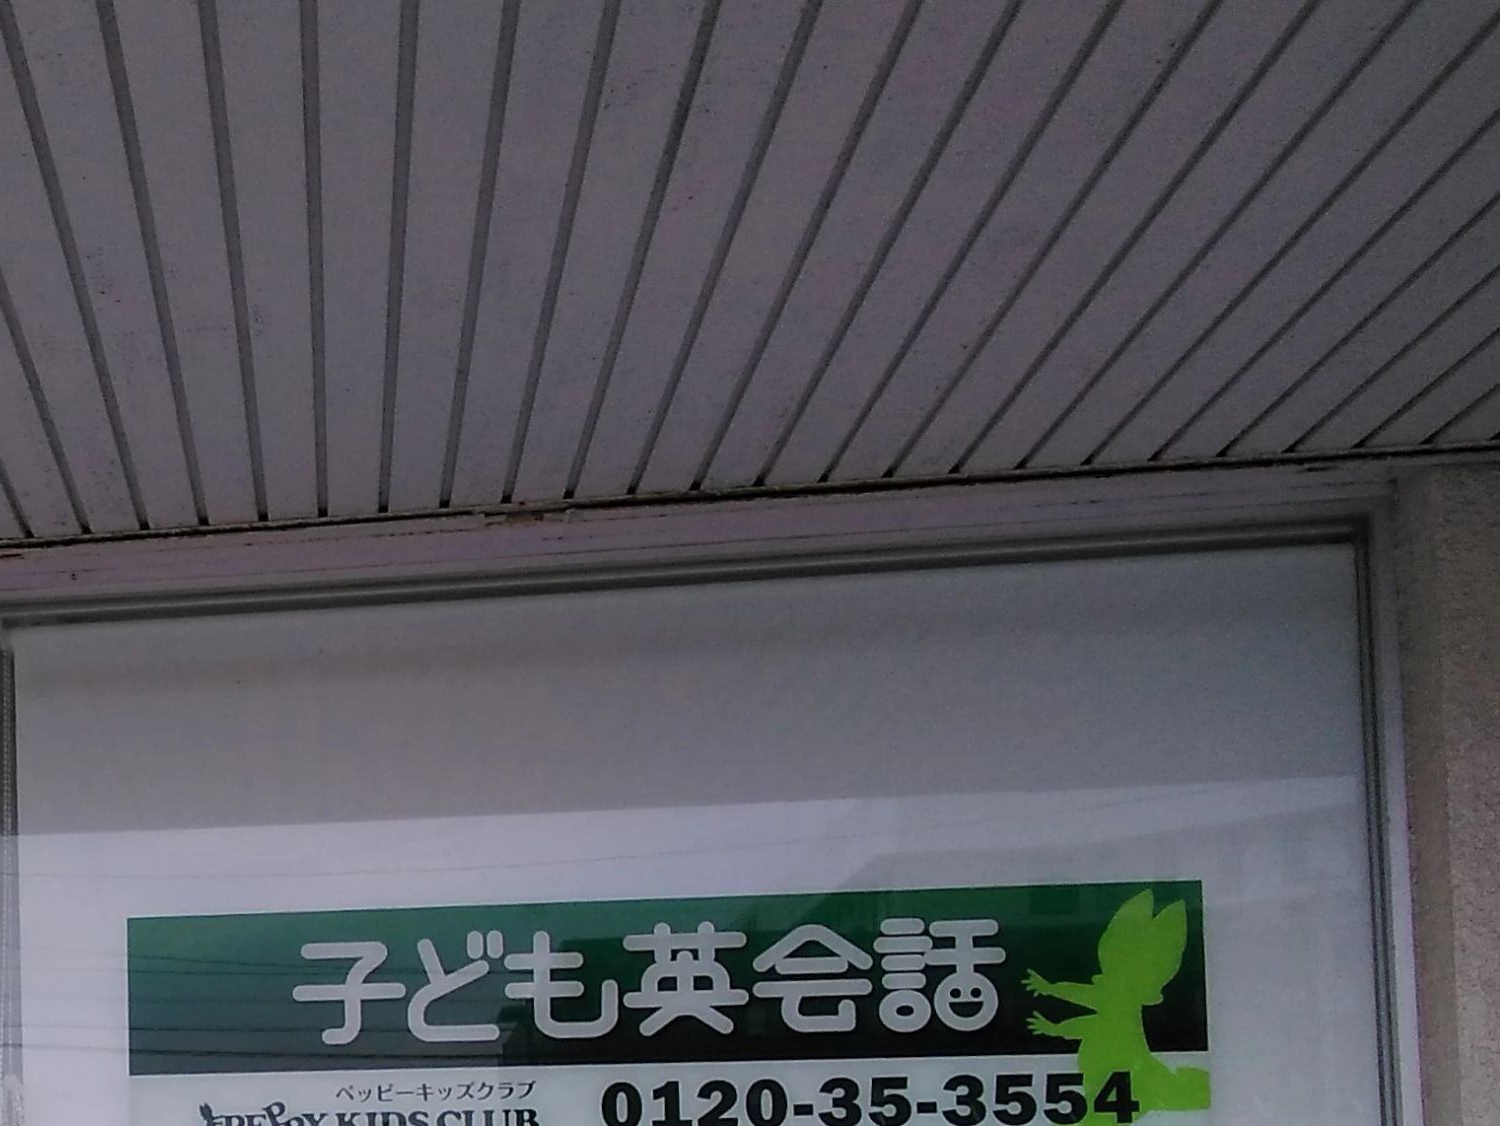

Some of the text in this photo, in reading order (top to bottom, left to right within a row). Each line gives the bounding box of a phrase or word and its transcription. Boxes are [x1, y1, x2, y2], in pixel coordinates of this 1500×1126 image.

[292, 917, 1007, 1046] 子ども英会話
